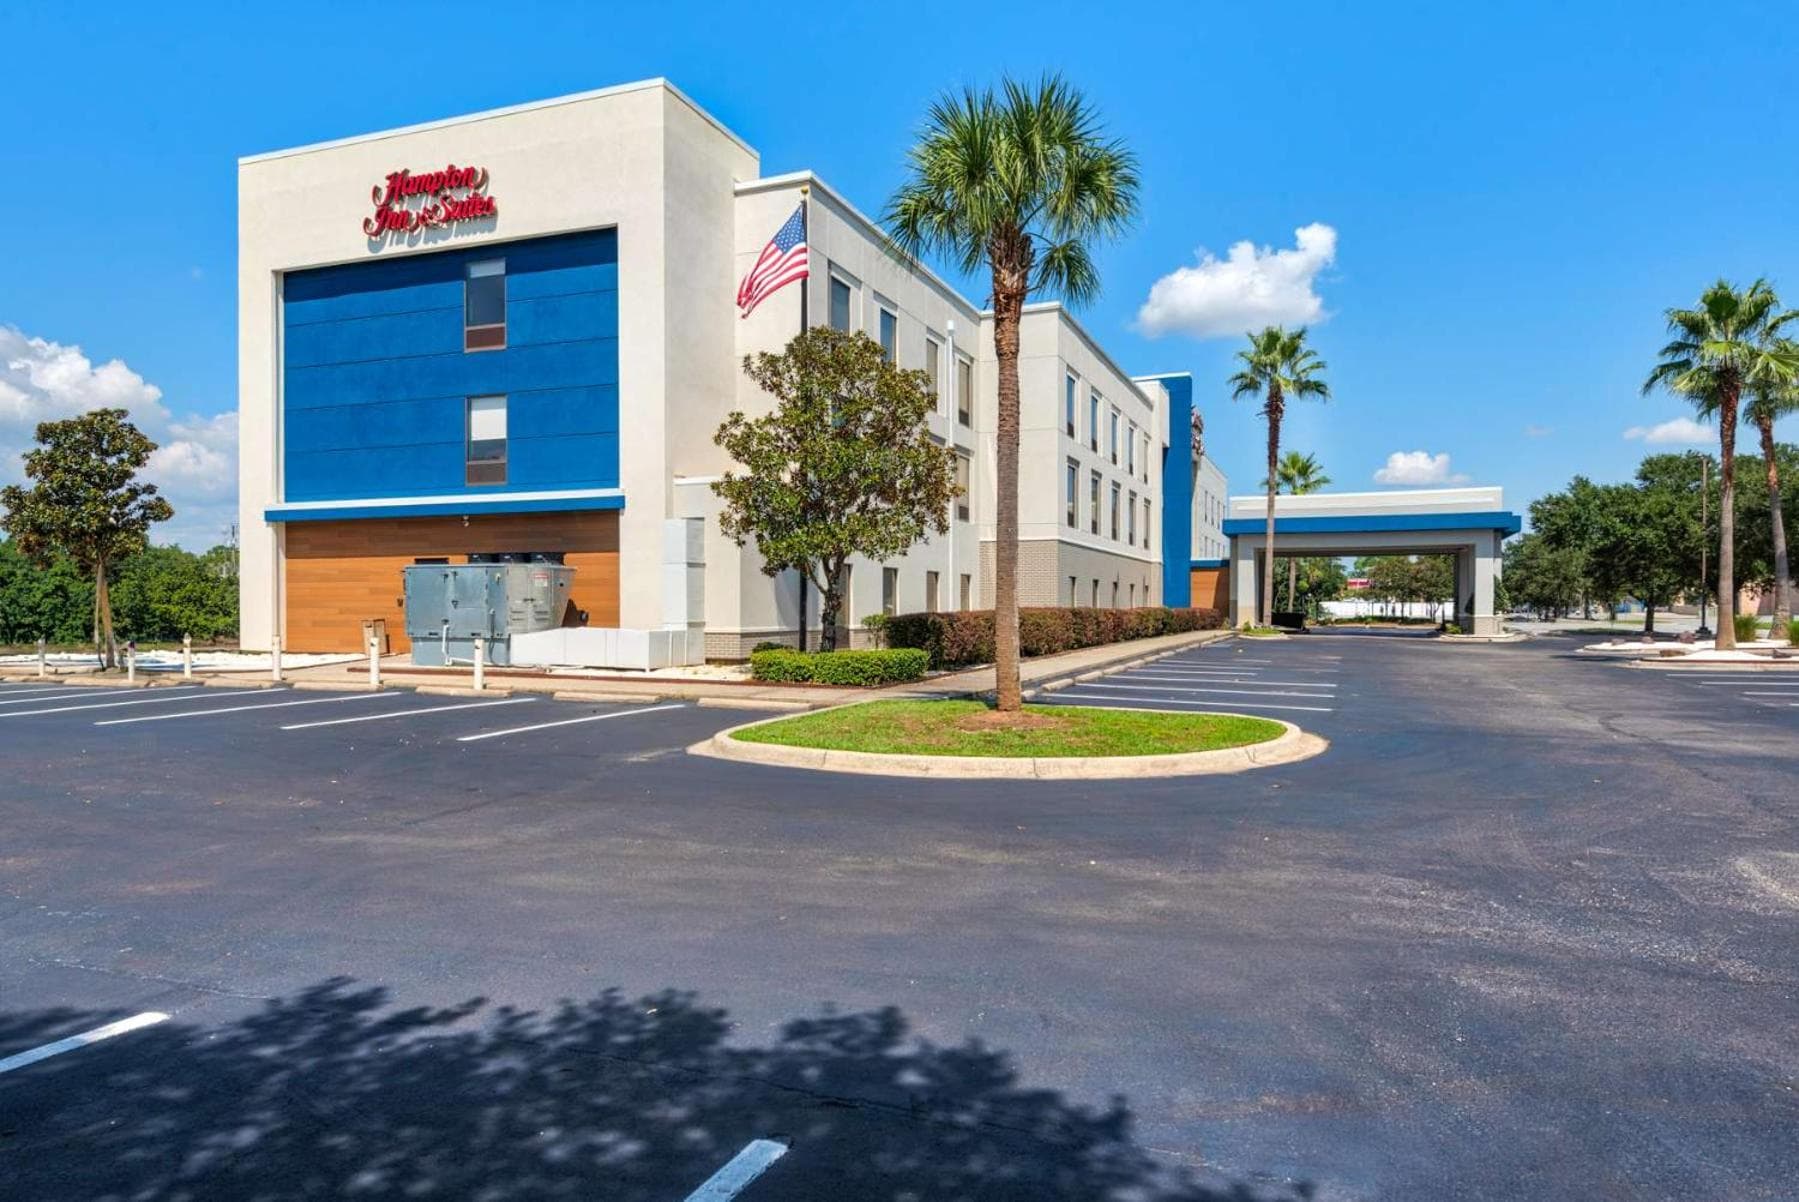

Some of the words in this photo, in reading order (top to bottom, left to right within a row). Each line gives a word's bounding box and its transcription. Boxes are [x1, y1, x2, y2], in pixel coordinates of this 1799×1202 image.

[372, 164, 489, 207] Hampton
[363, 204, 420, 236] Inn
[419, 204, 440, 226] &
[438, 191, 495, 222] Suites
